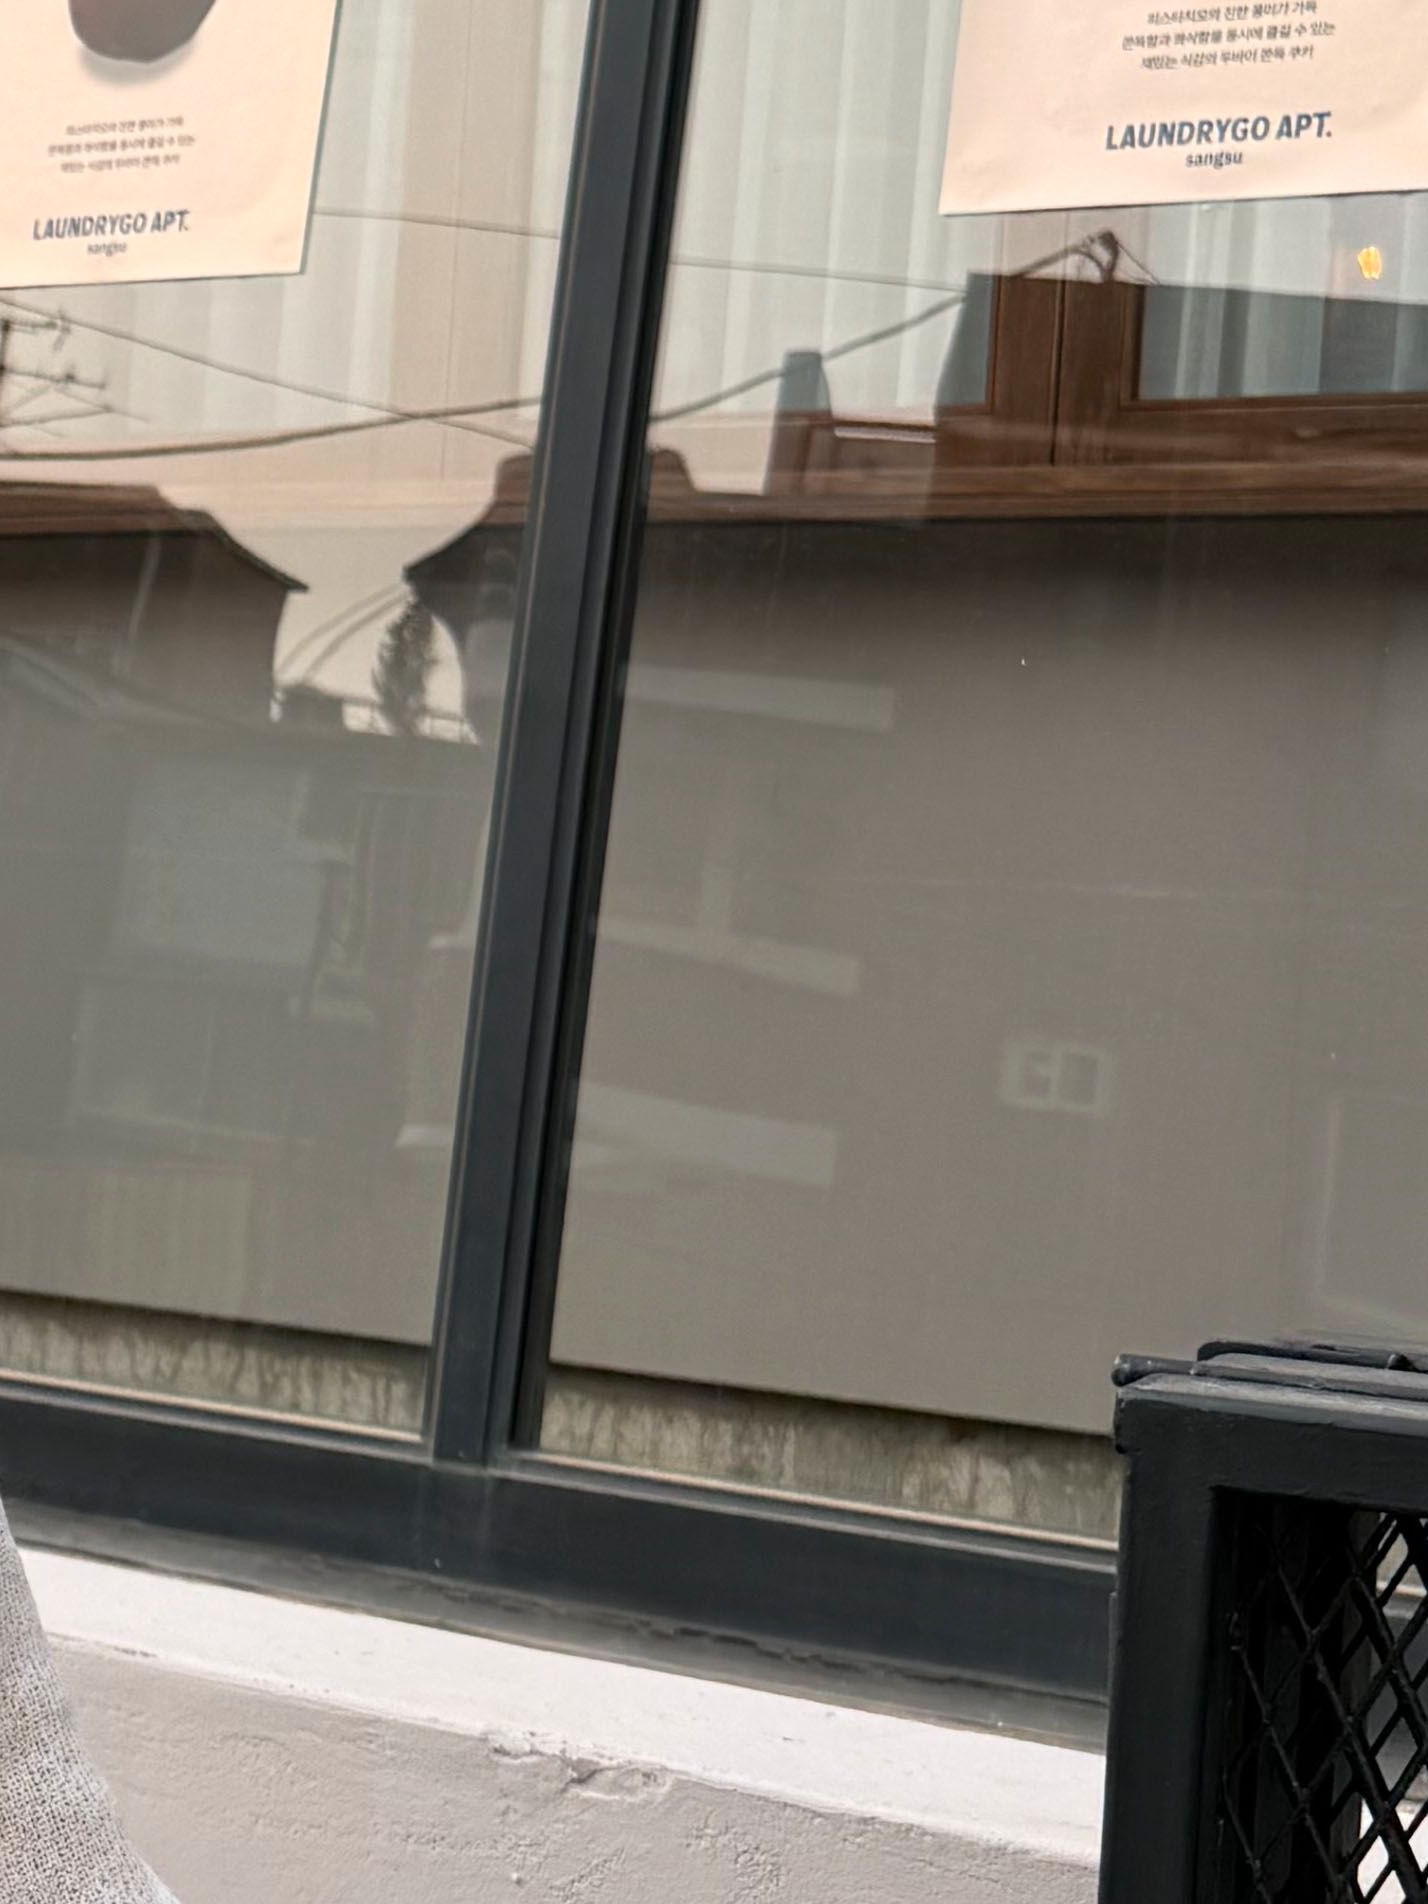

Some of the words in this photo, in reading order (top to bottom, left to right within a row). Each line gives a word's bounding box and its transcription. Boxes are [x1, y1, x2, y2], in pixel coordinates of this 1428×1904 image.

[1105, 116, 1271, 151] LAUNDRYGO
[1274, 111, 1333, 139] APT.
[1185, 151, 1244, 170] sangsu
[32, 212, 148, 241] LAUNDRYGO
